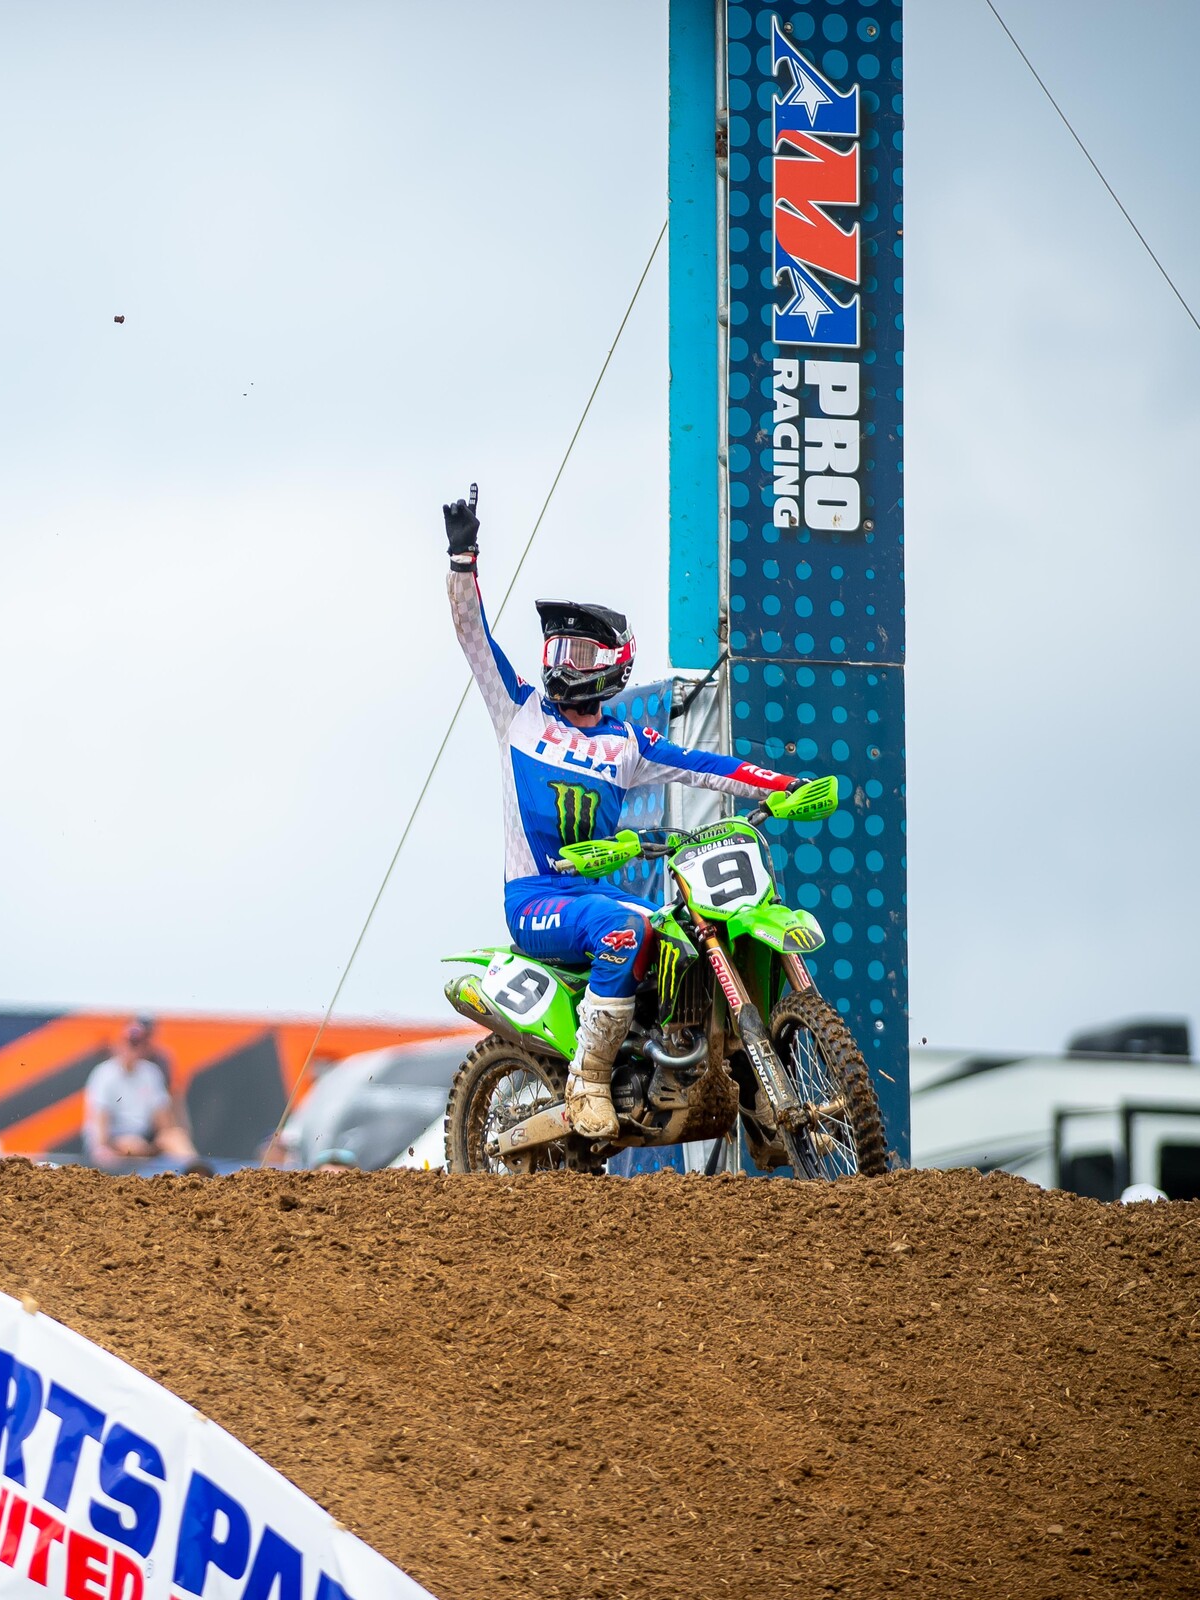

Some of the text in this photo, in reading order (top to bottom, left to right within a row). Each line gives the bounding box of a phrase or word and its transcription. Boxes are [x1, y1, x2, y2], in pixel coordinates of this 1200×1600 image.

[771, 15, 861, 349] AMA
[772, 359, 800, 529] RACING
[805, 359, 860, 531] PRO
[786, 798, 834, 817] ACERBIS
[583, 851, 631, 870] ACERBIS
[697, 840, 722, 856] LUCAS
[722, 837, 735, 847] OIL
[702, 850, 758, 907] 9
[494, 967, 550, 1015] 9
[707, 953, 742, 1008] SHOWA
[746, 1043, 778, 1106] DUNLOP
[172, 1469, 356, 1600] PA
